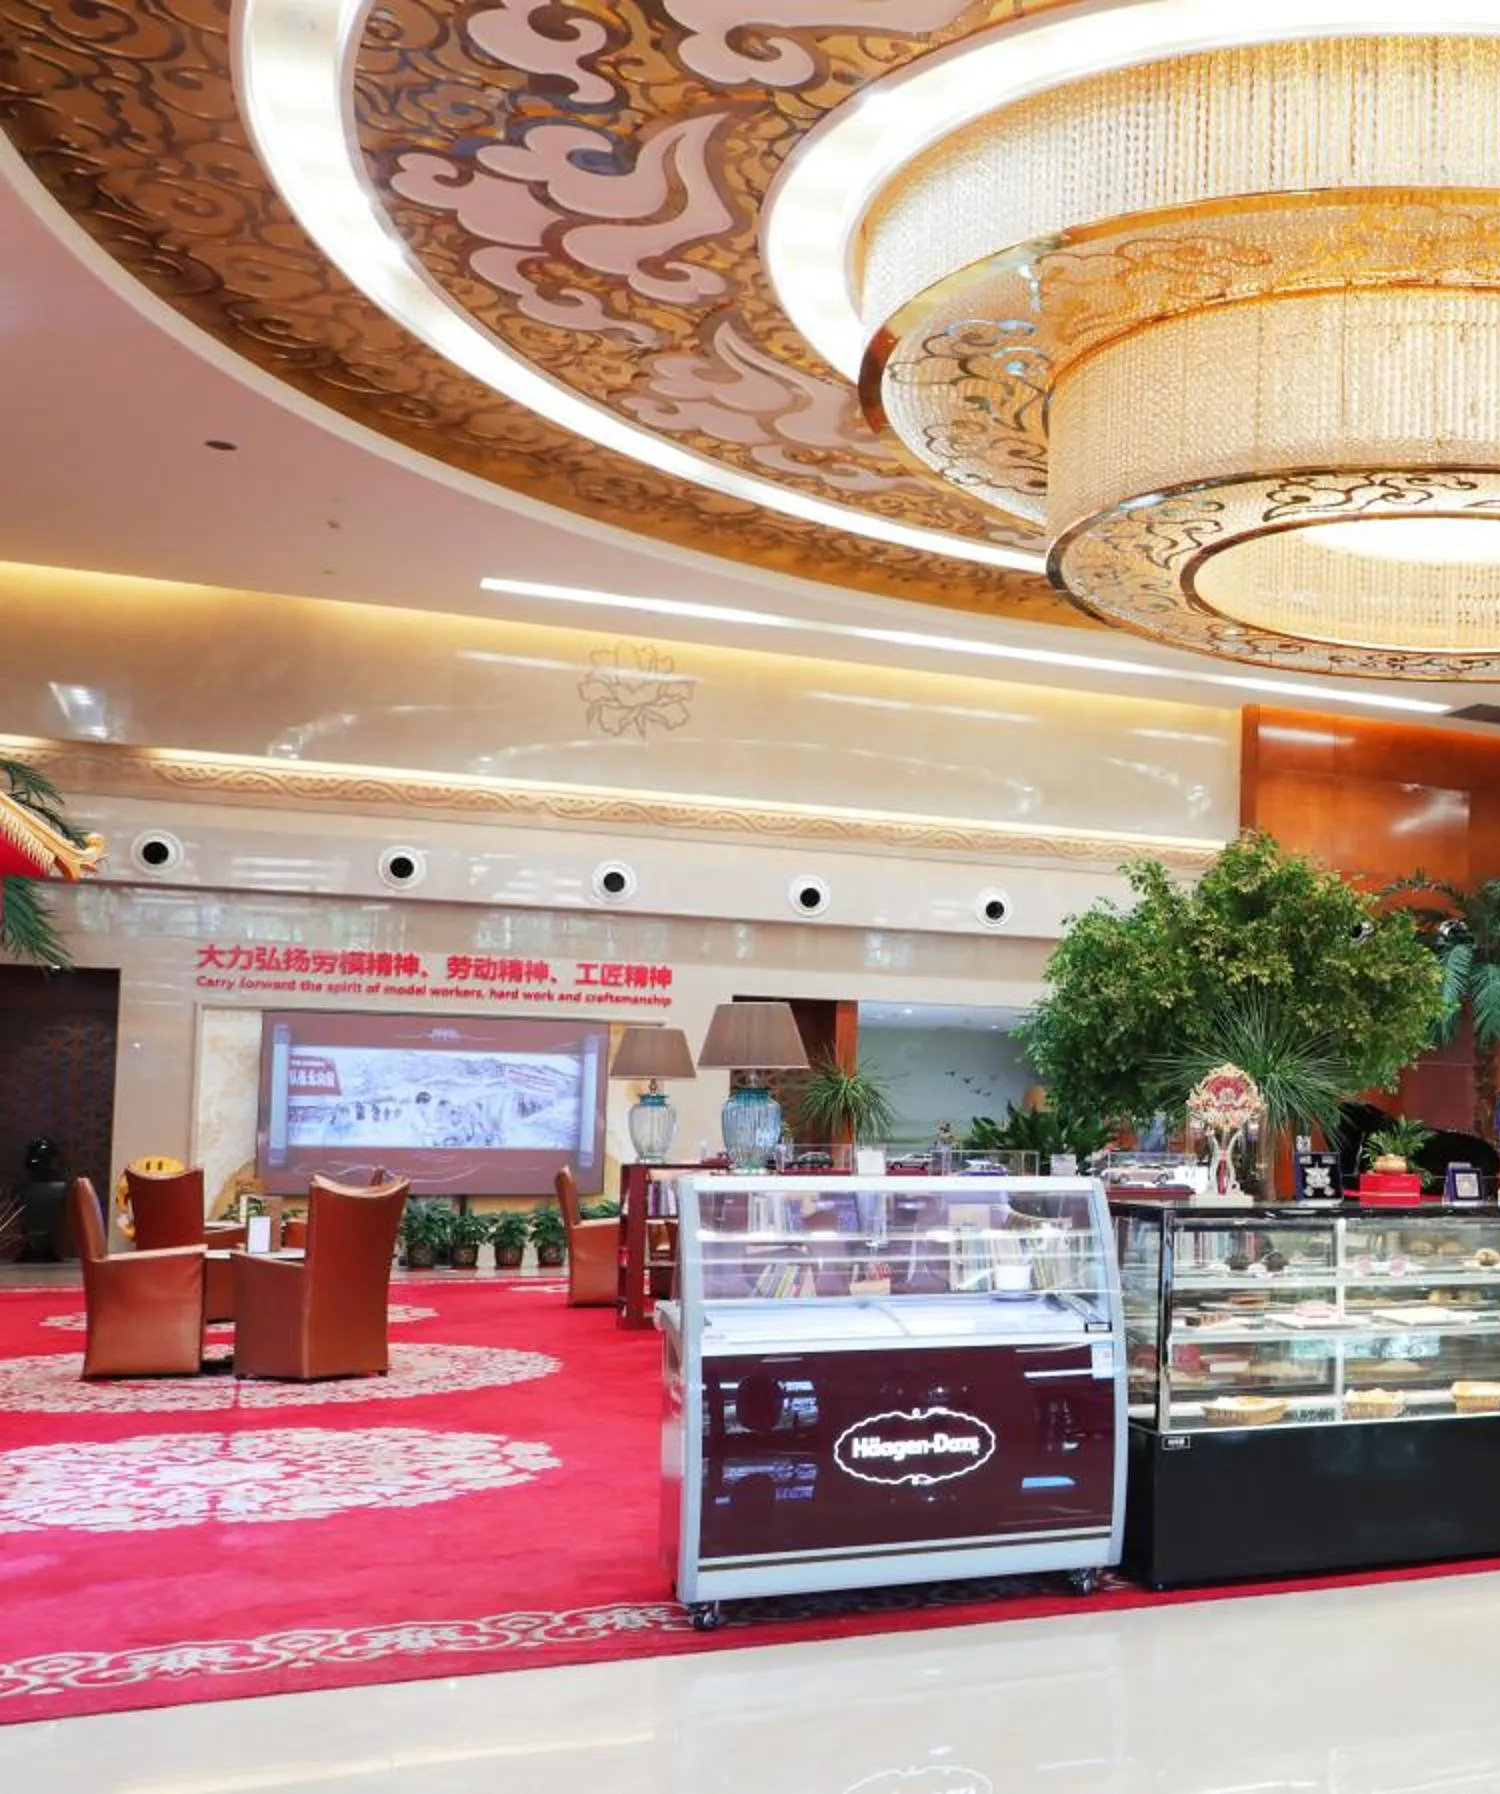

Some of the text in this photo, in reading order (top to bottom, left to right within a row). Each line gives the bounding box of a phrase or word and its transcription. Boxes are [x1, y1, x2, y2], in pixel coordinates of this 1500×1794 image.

[196, 975, 234, 992] Carry
[239, 976, 296, 991] forward
[300, 979, 322, 992] the
[327, 980, 362, 995] spirit
[366, 983, 380, 994] of
[384, 983, 427, 997] model
[490, 988, 519, 1000] hard
[522, 989, 554, 1002] work
[559, 991, 581, 1003] and
[585, 991, 673, 1008] craftsmanship
